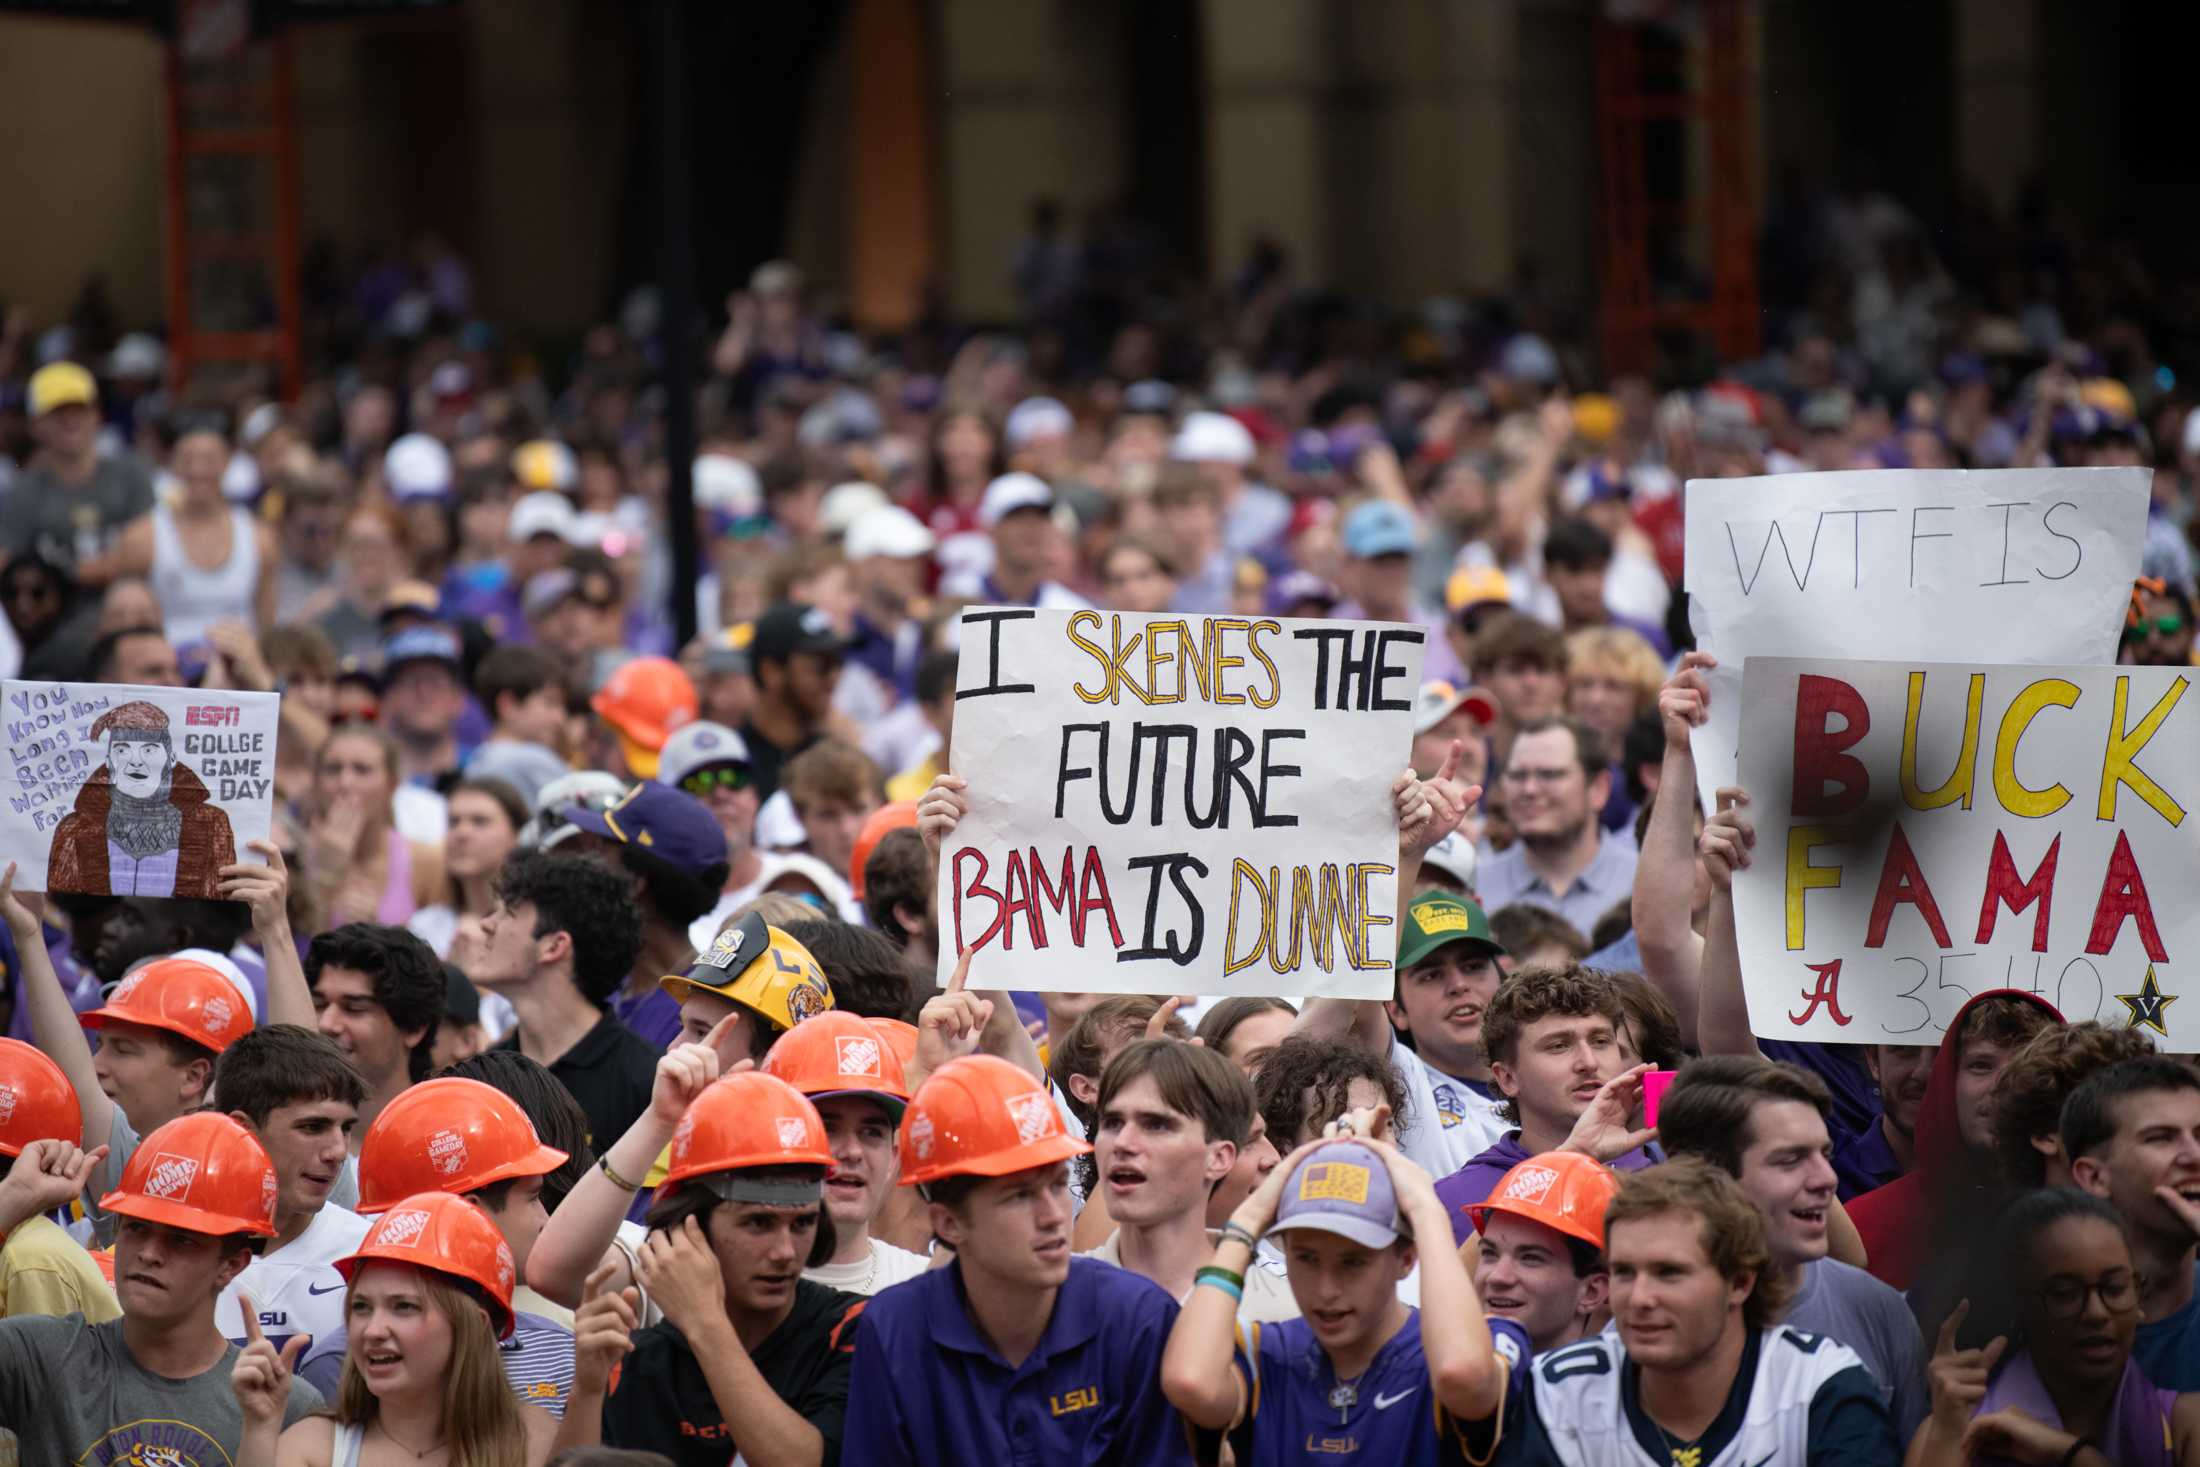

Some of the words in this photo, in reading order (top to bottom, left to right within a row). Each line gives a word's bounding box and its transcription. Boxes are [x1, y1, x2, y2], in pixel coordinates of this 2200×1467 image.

[1725, 506, 1955, 596] WTF
[1980, 501, 2083, 588] IS
[955, 610, 1036, 701] I
[1067, 610, 1281, 709] SKENES
[1293, 630, 1425, 712] THE
[10, 687, 69, 716] You
[201, 758, 262, 777] GAME
[1054, 721, 1306, 829] FUTURE
[1791, 670, 2190, 828] BUCK
[220, 778, 271, 802] DAY
[952, 846, 1125, 960] BAMA
[1117, 853, 1209, 966] IS
[1223, 857, 1395, 977] DUNNE
[1785, 821, 2170, 965] FAMA
[147, 1159, 194, 1195] HOME
[258, 1312, 287, 1326] SU
[1049, 1386, 1099, 1417] LSU
